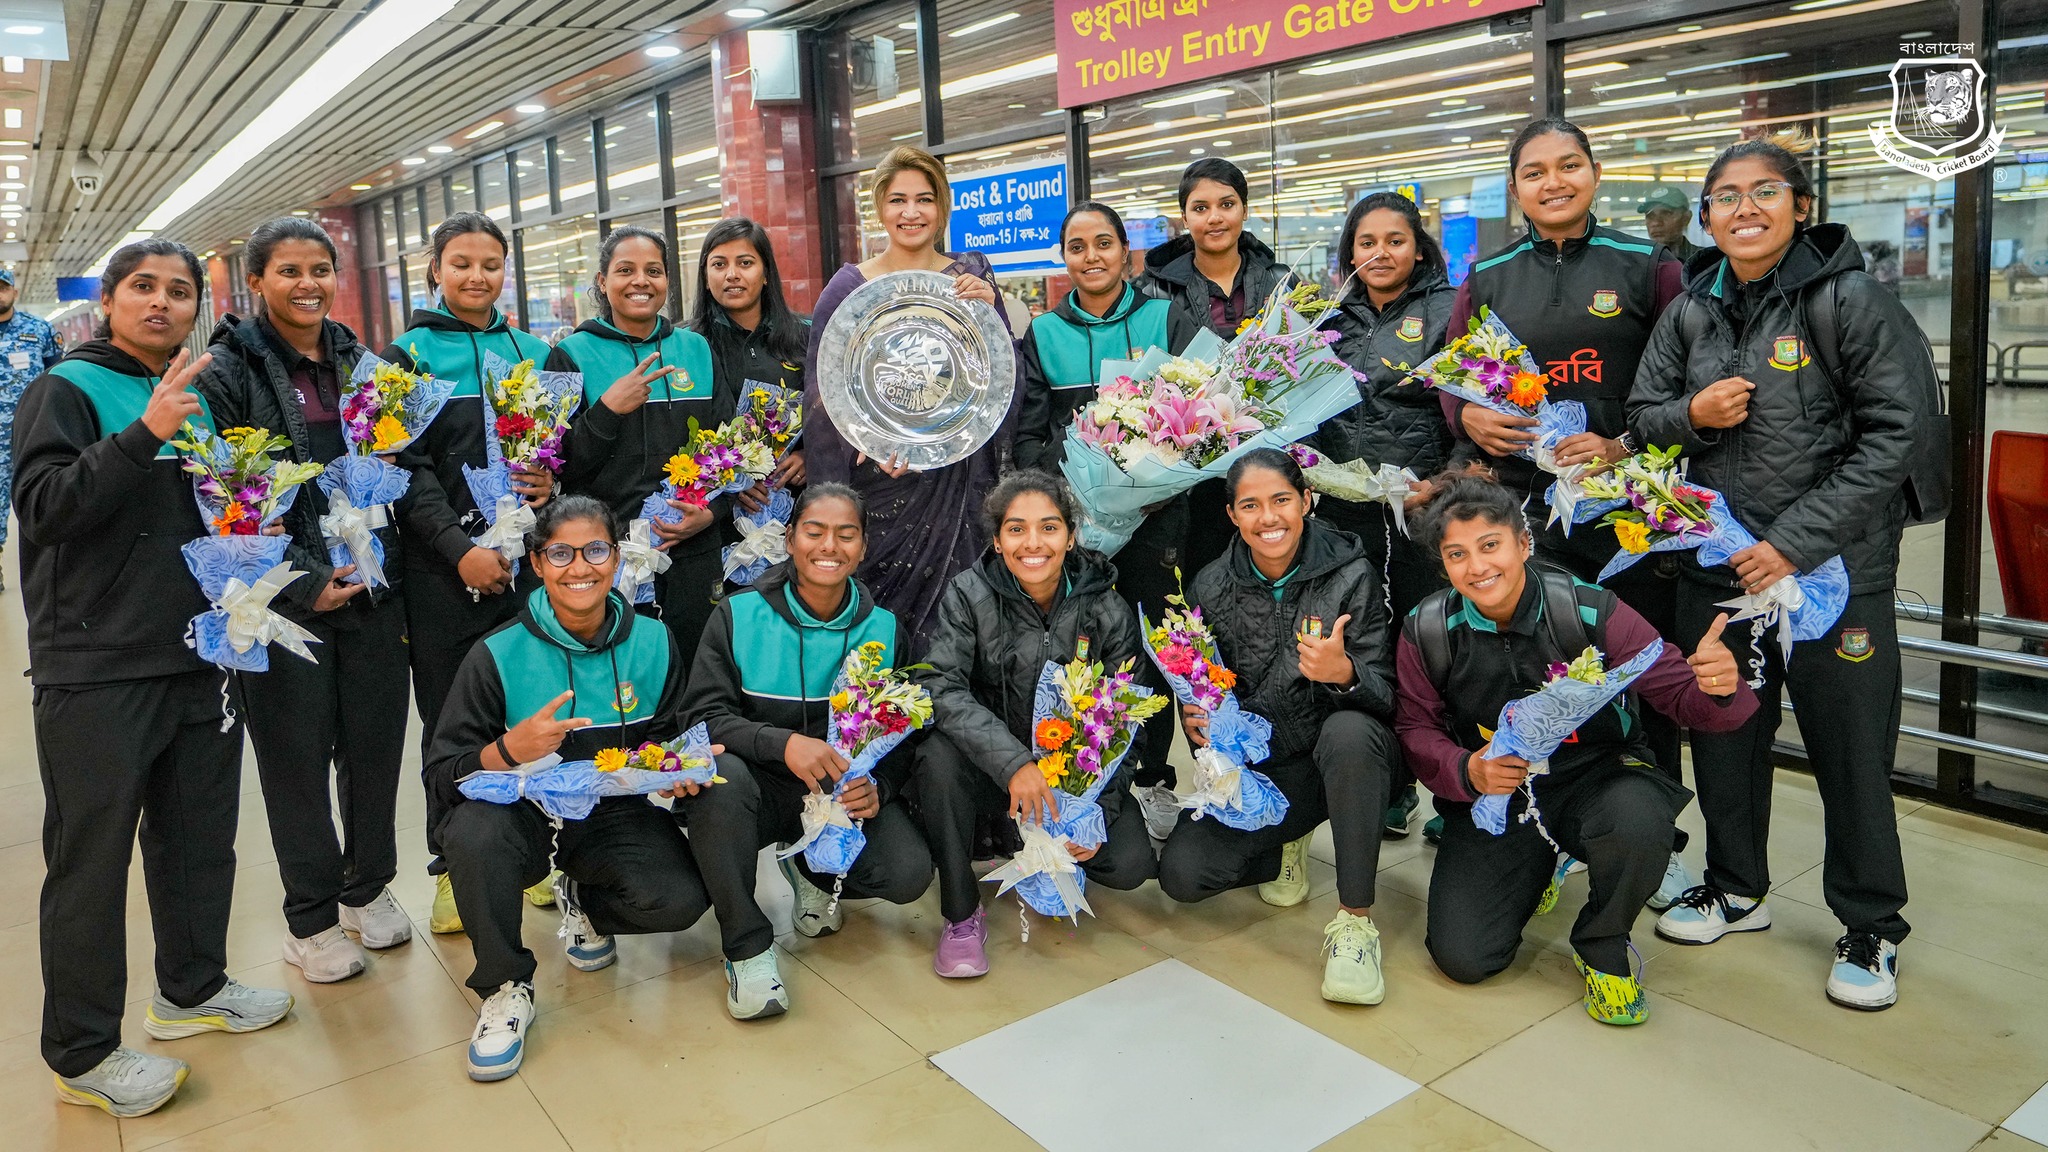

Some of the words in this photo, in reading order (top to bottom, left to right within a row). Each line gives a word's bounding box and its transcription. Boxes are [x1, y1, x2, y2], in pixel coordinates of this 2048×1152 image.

[1075, 46, 1172, 88] Trolley
[1183, 21, 1272, 64] Entry
[1283, 0, 1374, 39] Gate
[951, 185, 985, 212] Lost
[989, 181, 1003, 206] &
[1006, 171, 1063, 204] Found
[977, 210, 1003, 228] হারানো
[1006, 213, 1013, 223] ও
[965, 228, 1011, 248] Room-15
[1013, 227, 1018, 243] /
[1019, 226, 1050, 241] কক্ষ-১৫
[894, 278, 977, 310] WINNES
[1545, 348, 1604, 387] রবি
